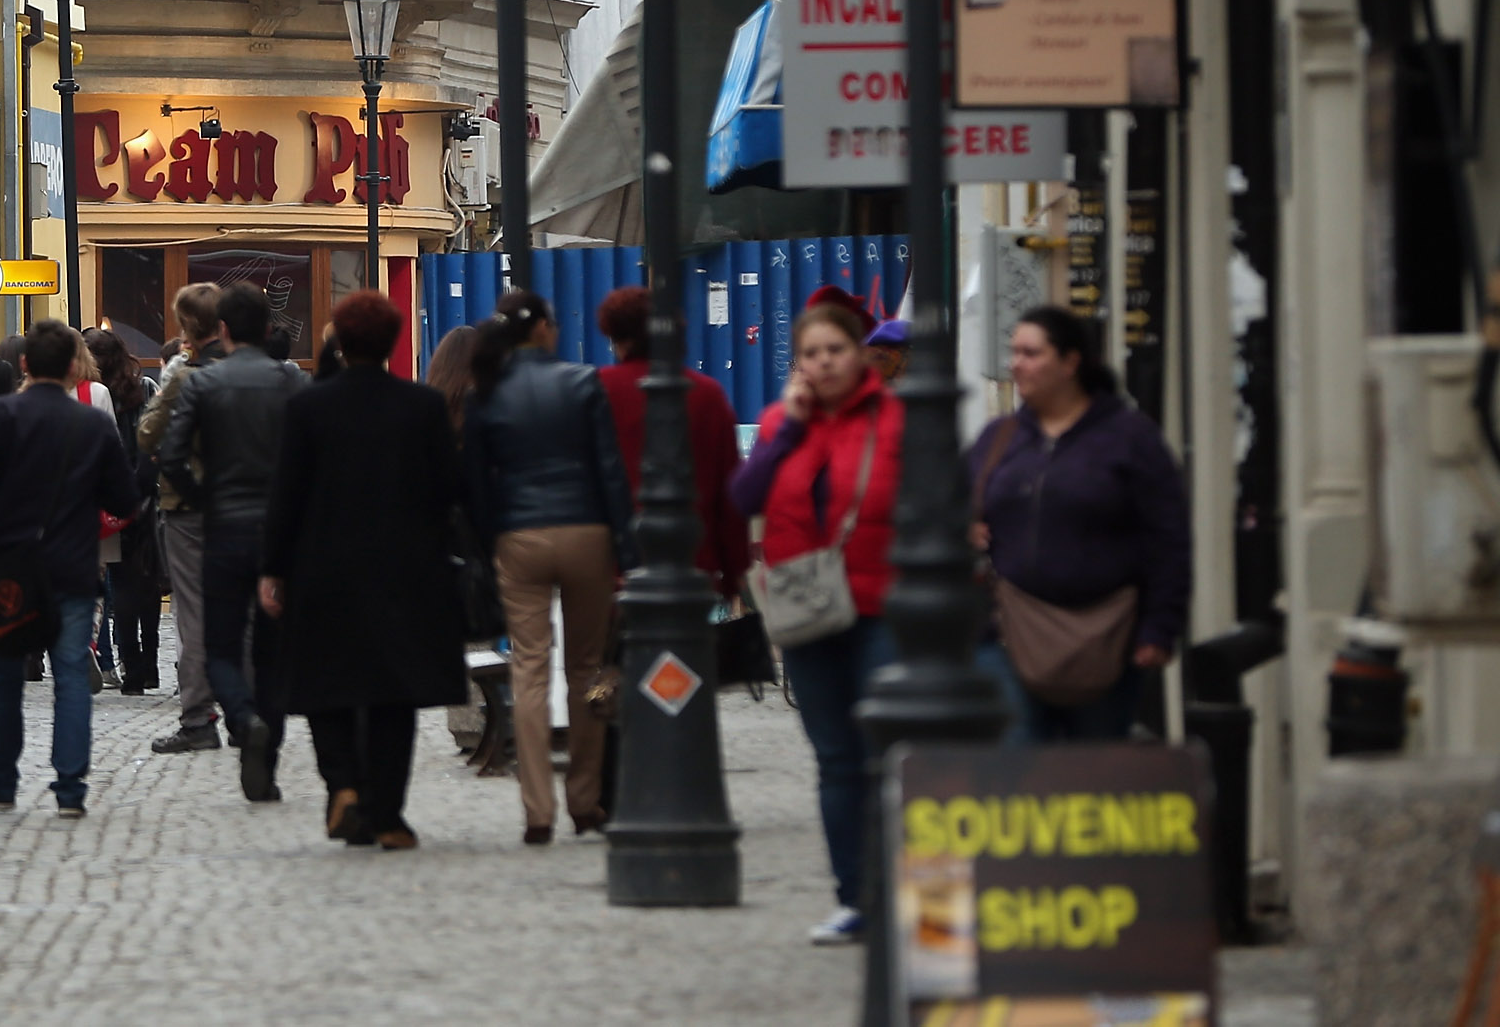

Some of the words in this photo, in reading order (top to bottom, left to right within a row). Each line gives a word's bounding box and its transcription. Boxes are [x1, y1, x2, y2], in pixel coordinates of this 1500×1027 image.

[304, 110, 412, 205] Pub
[5, 280, 56, 289] BANCOMAT
[903, 792, 1199, 859] SOUVENIR
[977, 884, 1139, 952] SHOP
